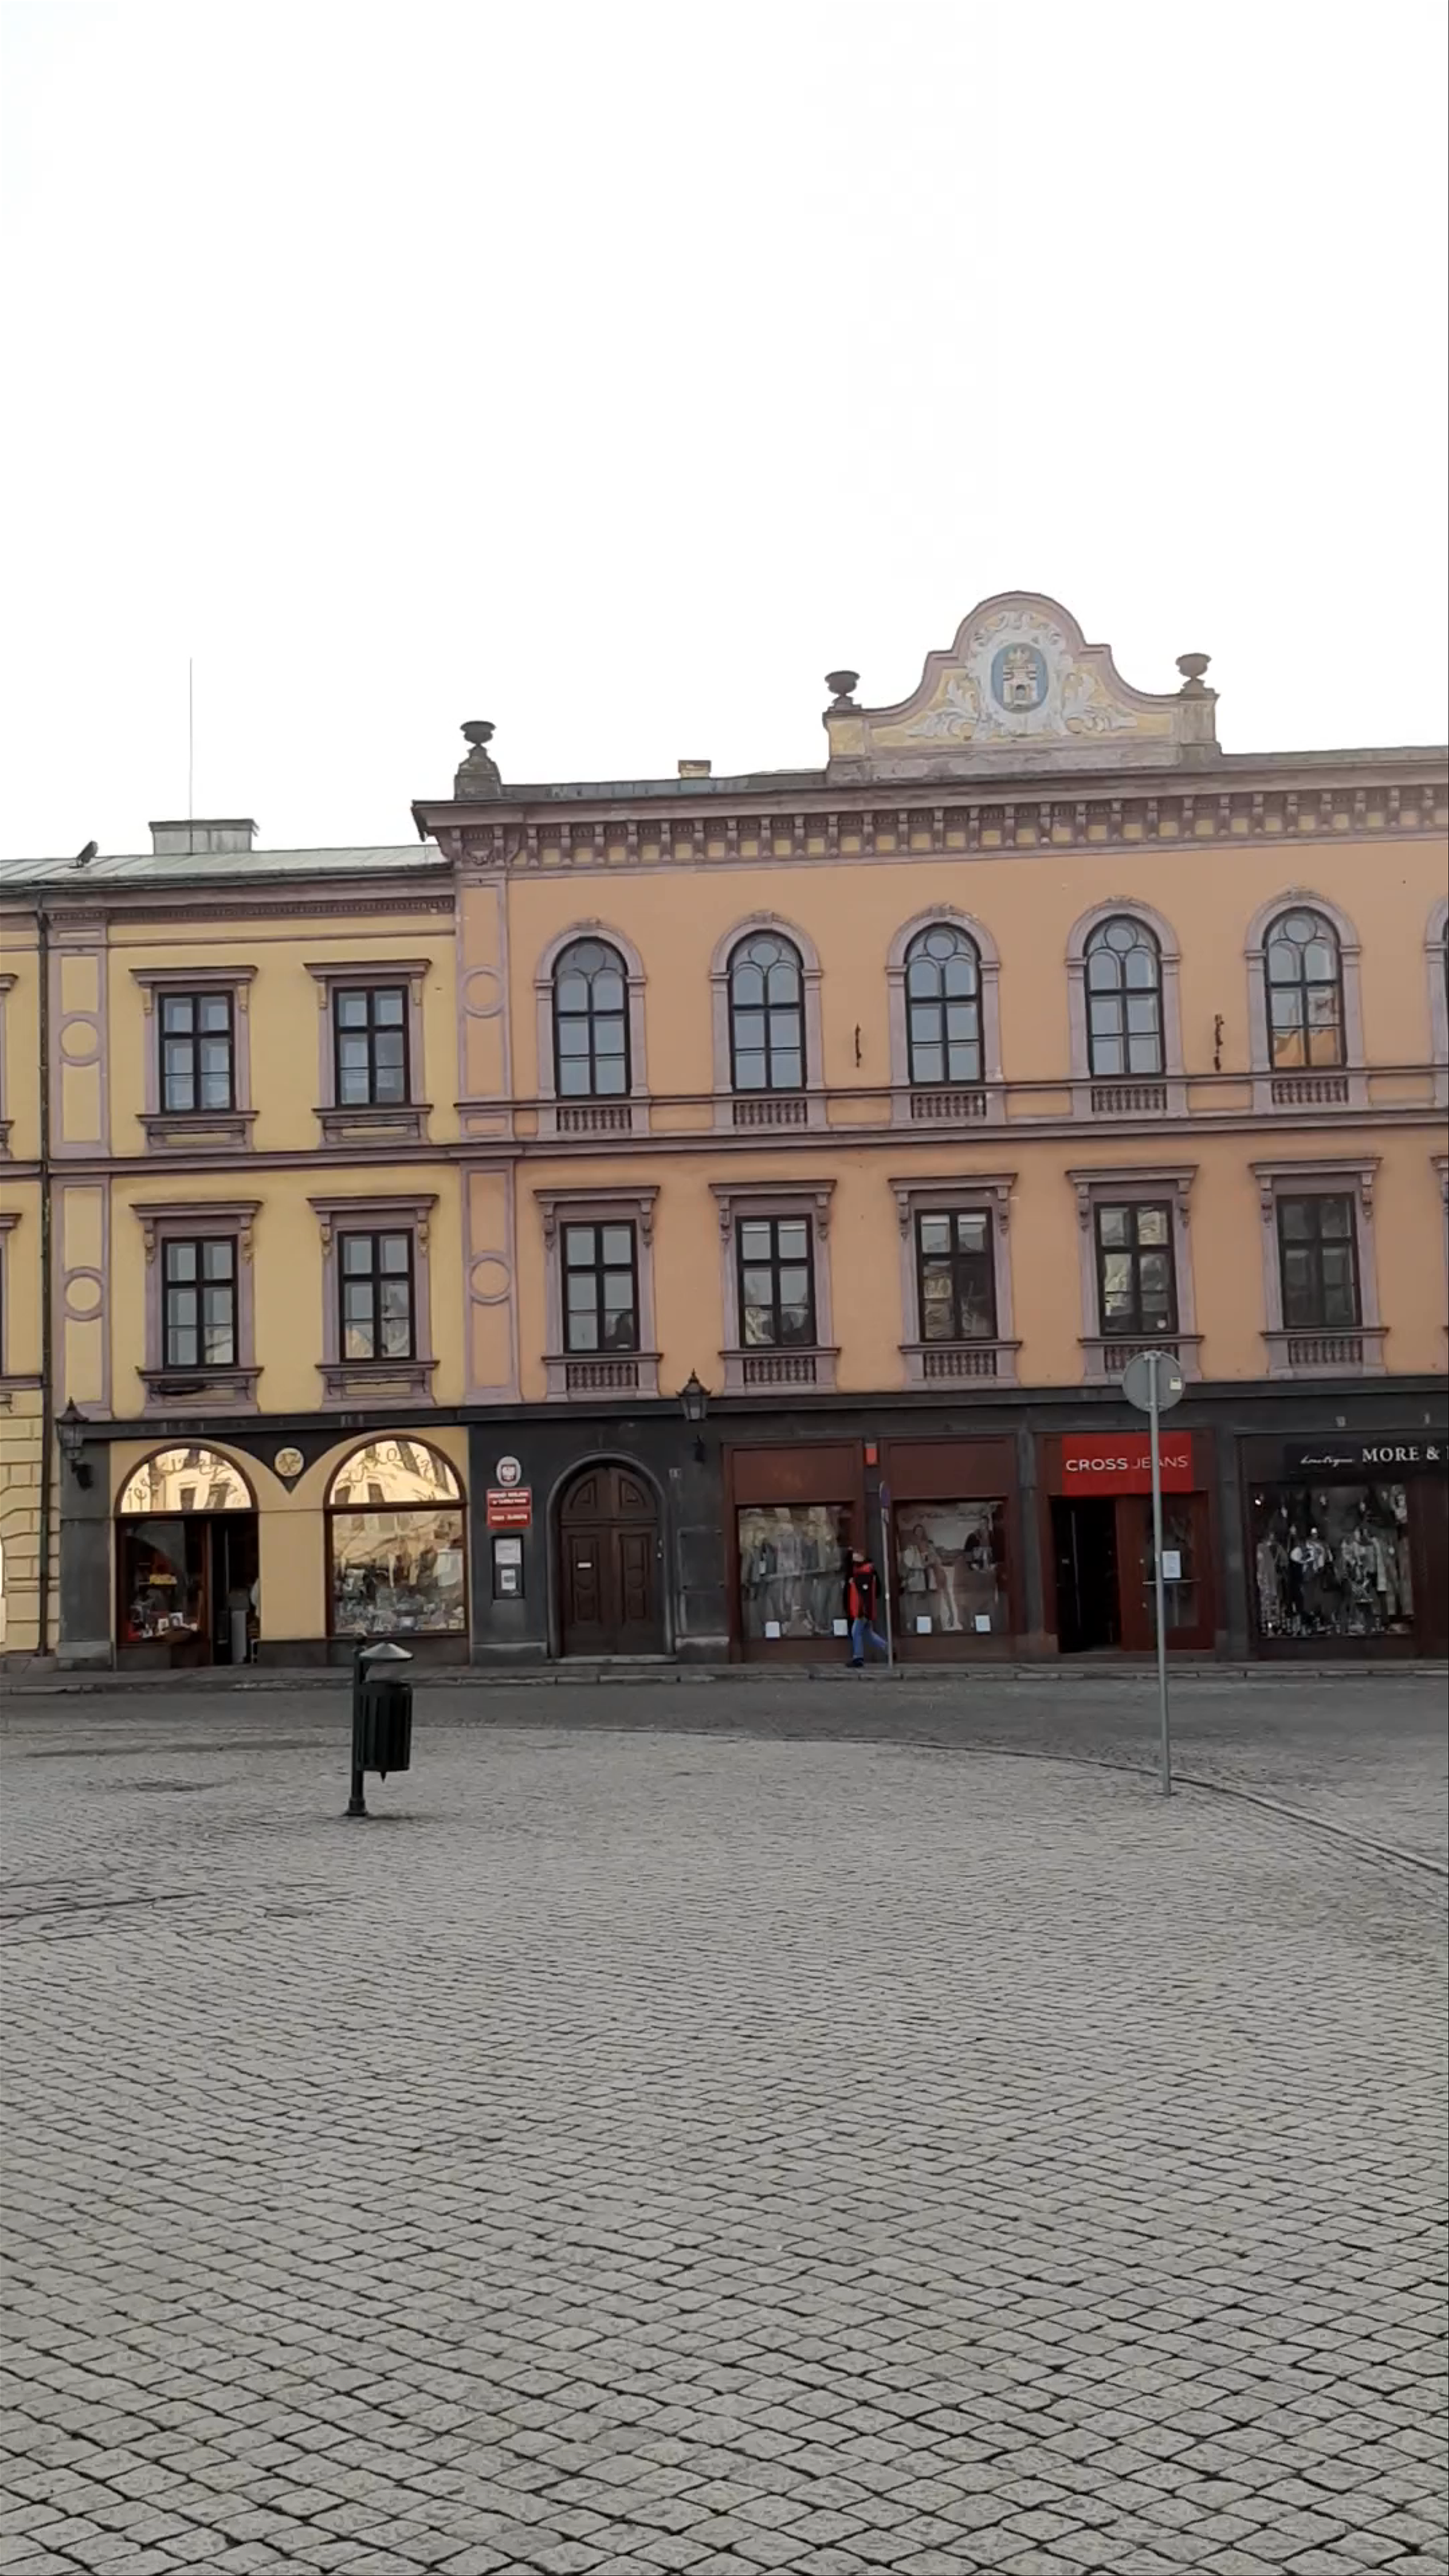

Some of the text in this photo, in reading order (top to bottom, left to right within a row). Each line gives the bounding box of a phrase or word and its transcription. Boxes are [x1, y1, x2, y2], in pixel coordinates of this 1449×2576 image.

[1362, 1447, 1419, 1463] MORE
[1427, 1445, 1440, 1460] &
[1066, 1458, 1128, 1471] CROSS
